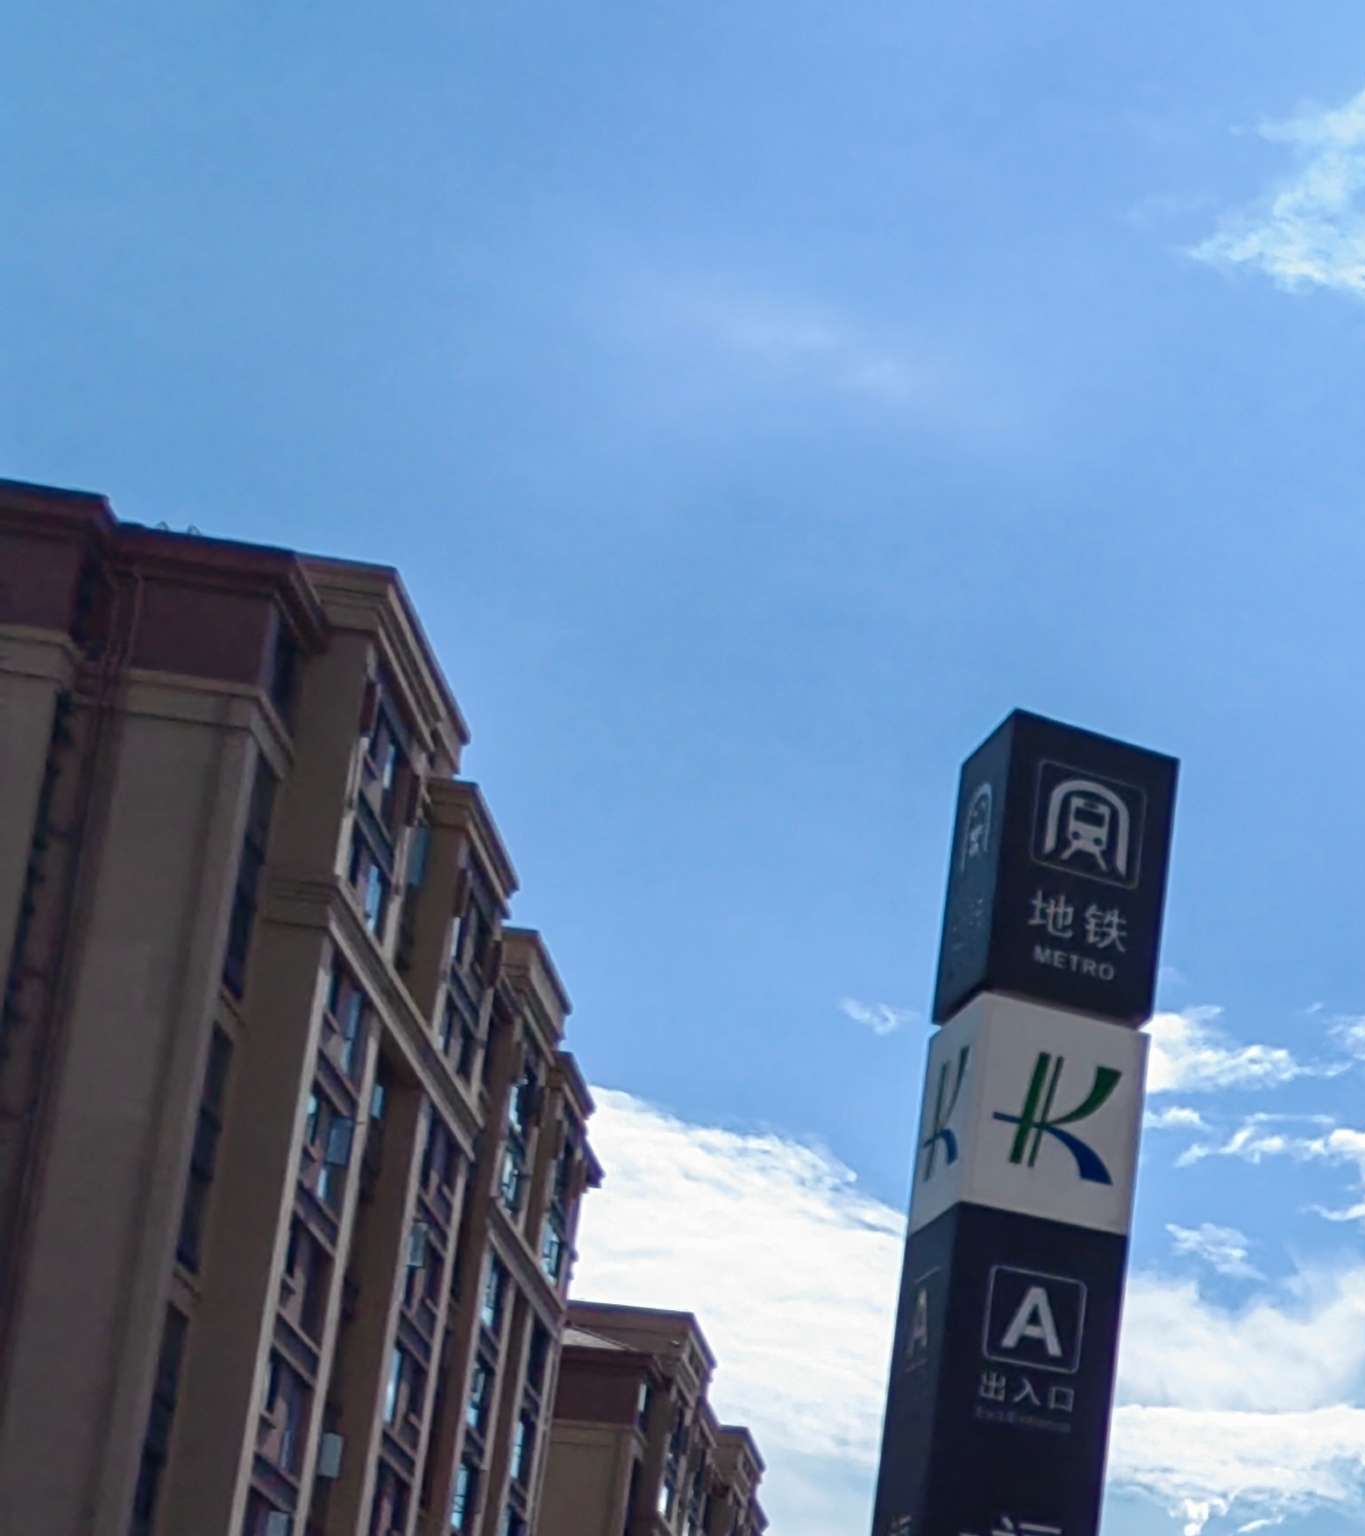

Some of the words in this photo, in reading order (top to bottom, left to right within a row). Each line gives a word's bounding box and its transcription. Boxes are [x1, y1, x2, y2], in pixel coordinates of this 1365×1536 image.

[1028, 889, 1128, 953] 地铁
[1033, 944, 1115, 981] METRO
[1001, 1286, 1064, 1357] A
[978, 1370, 1075, 1412] 出入口
